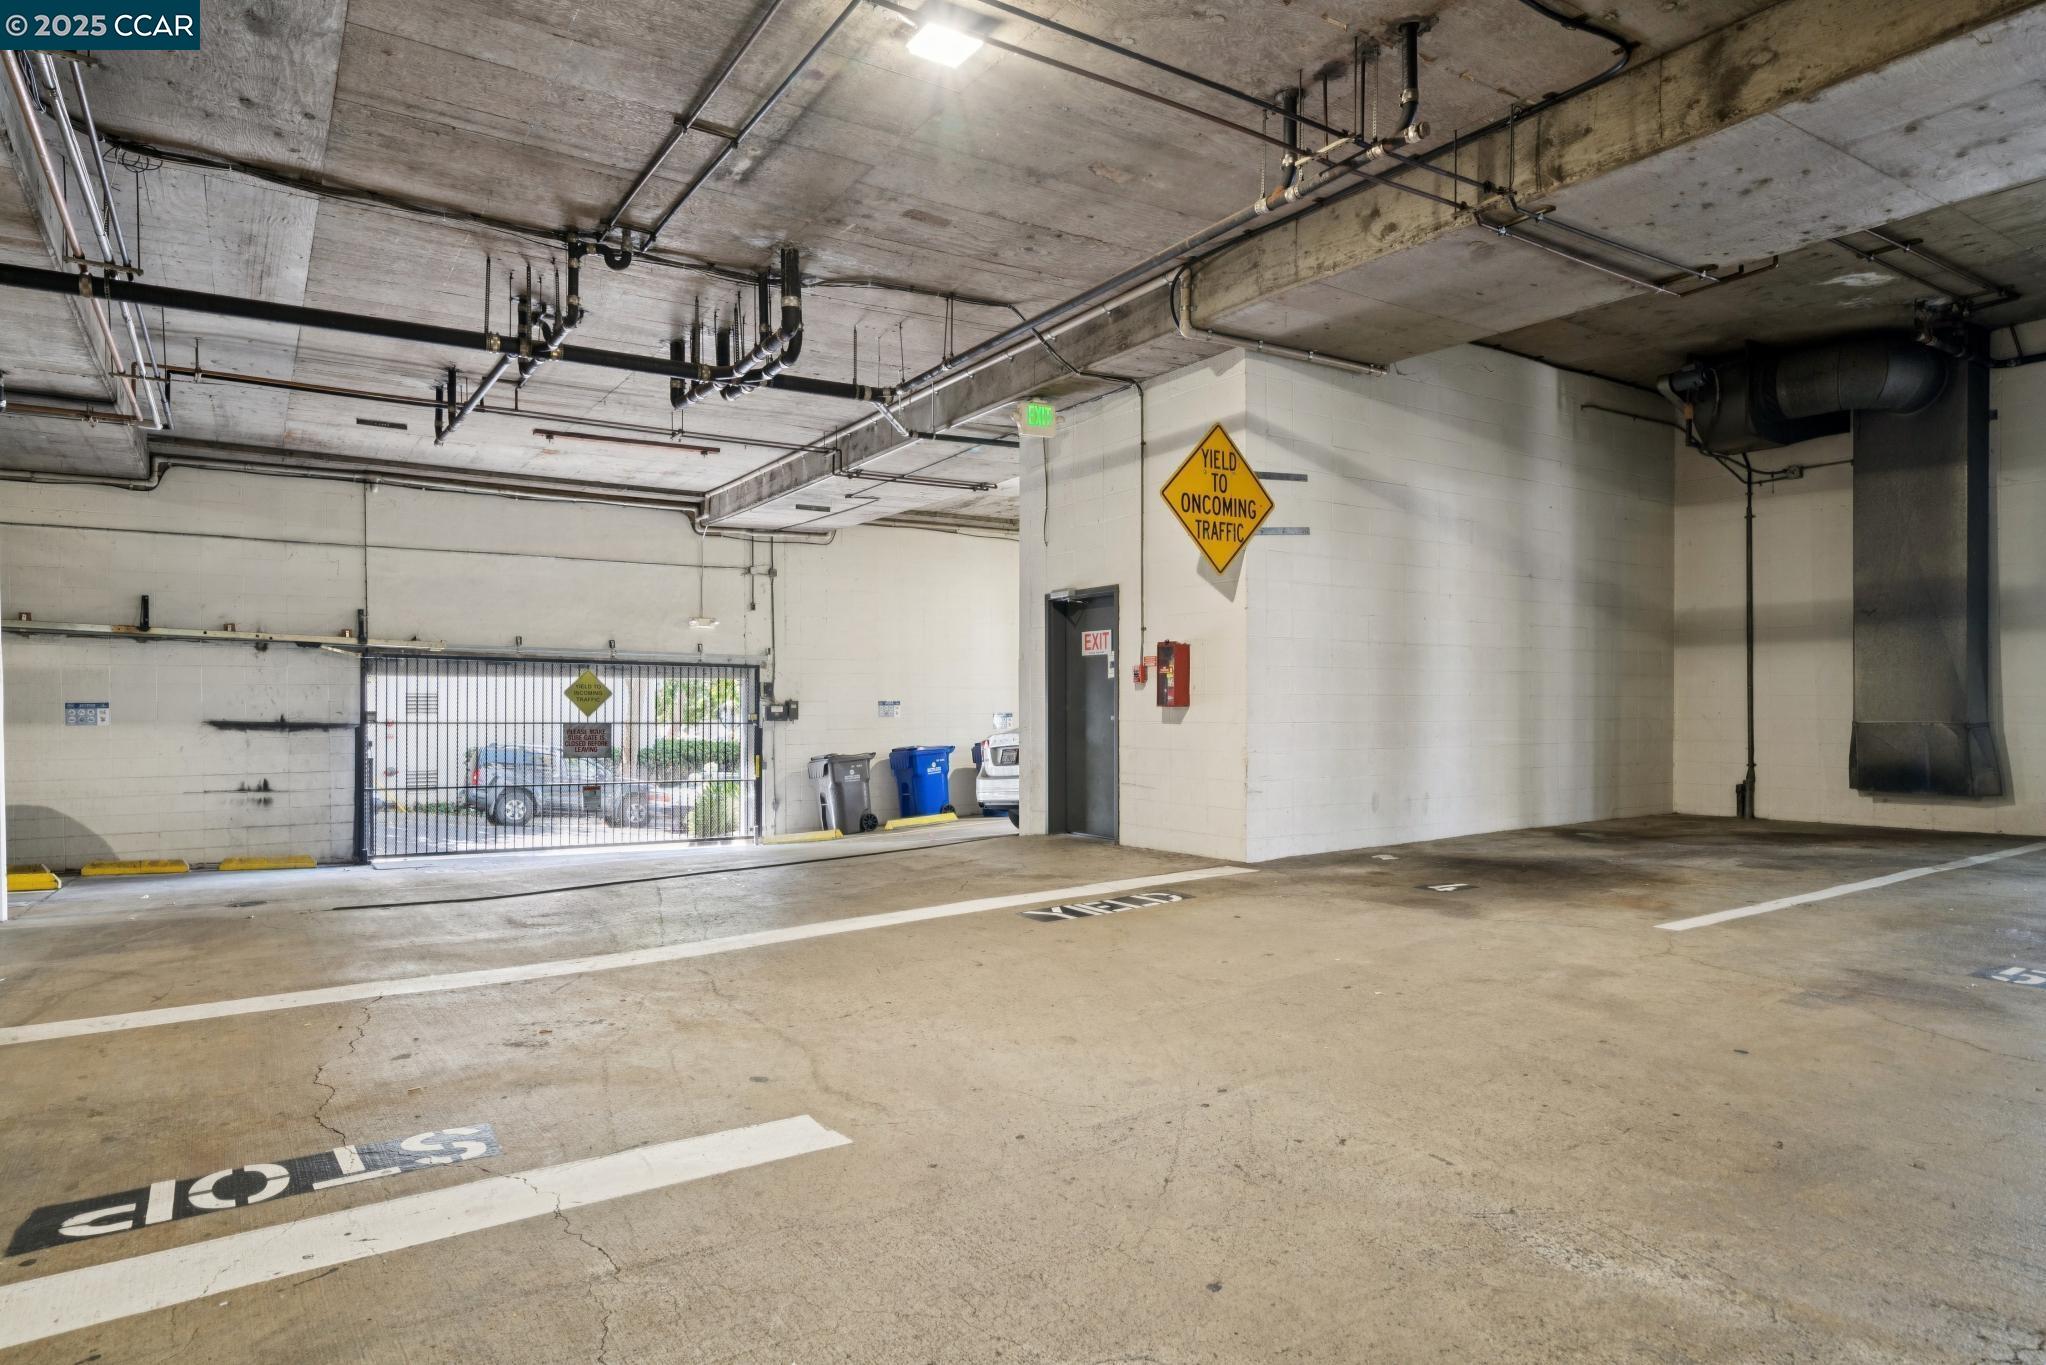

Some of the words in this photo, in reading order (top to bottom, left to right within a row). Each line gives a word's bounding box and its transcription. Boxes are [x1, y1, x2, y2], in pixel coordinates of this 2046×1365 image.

[1028, 404, 1052, 425] EXIT
[1201, 448, 1237, 472] YIELD
[1212, 473, 1228, 493] TO
[1181, 492, 1257, 520] ONCOMING
[1195, 519, 1245, 543] TRAFFIC
[1084, 632, 1109, 651] EXIT
[1022, 892, 1183, 920] YIELD
[57, 1126, 488, 1237] STOP
